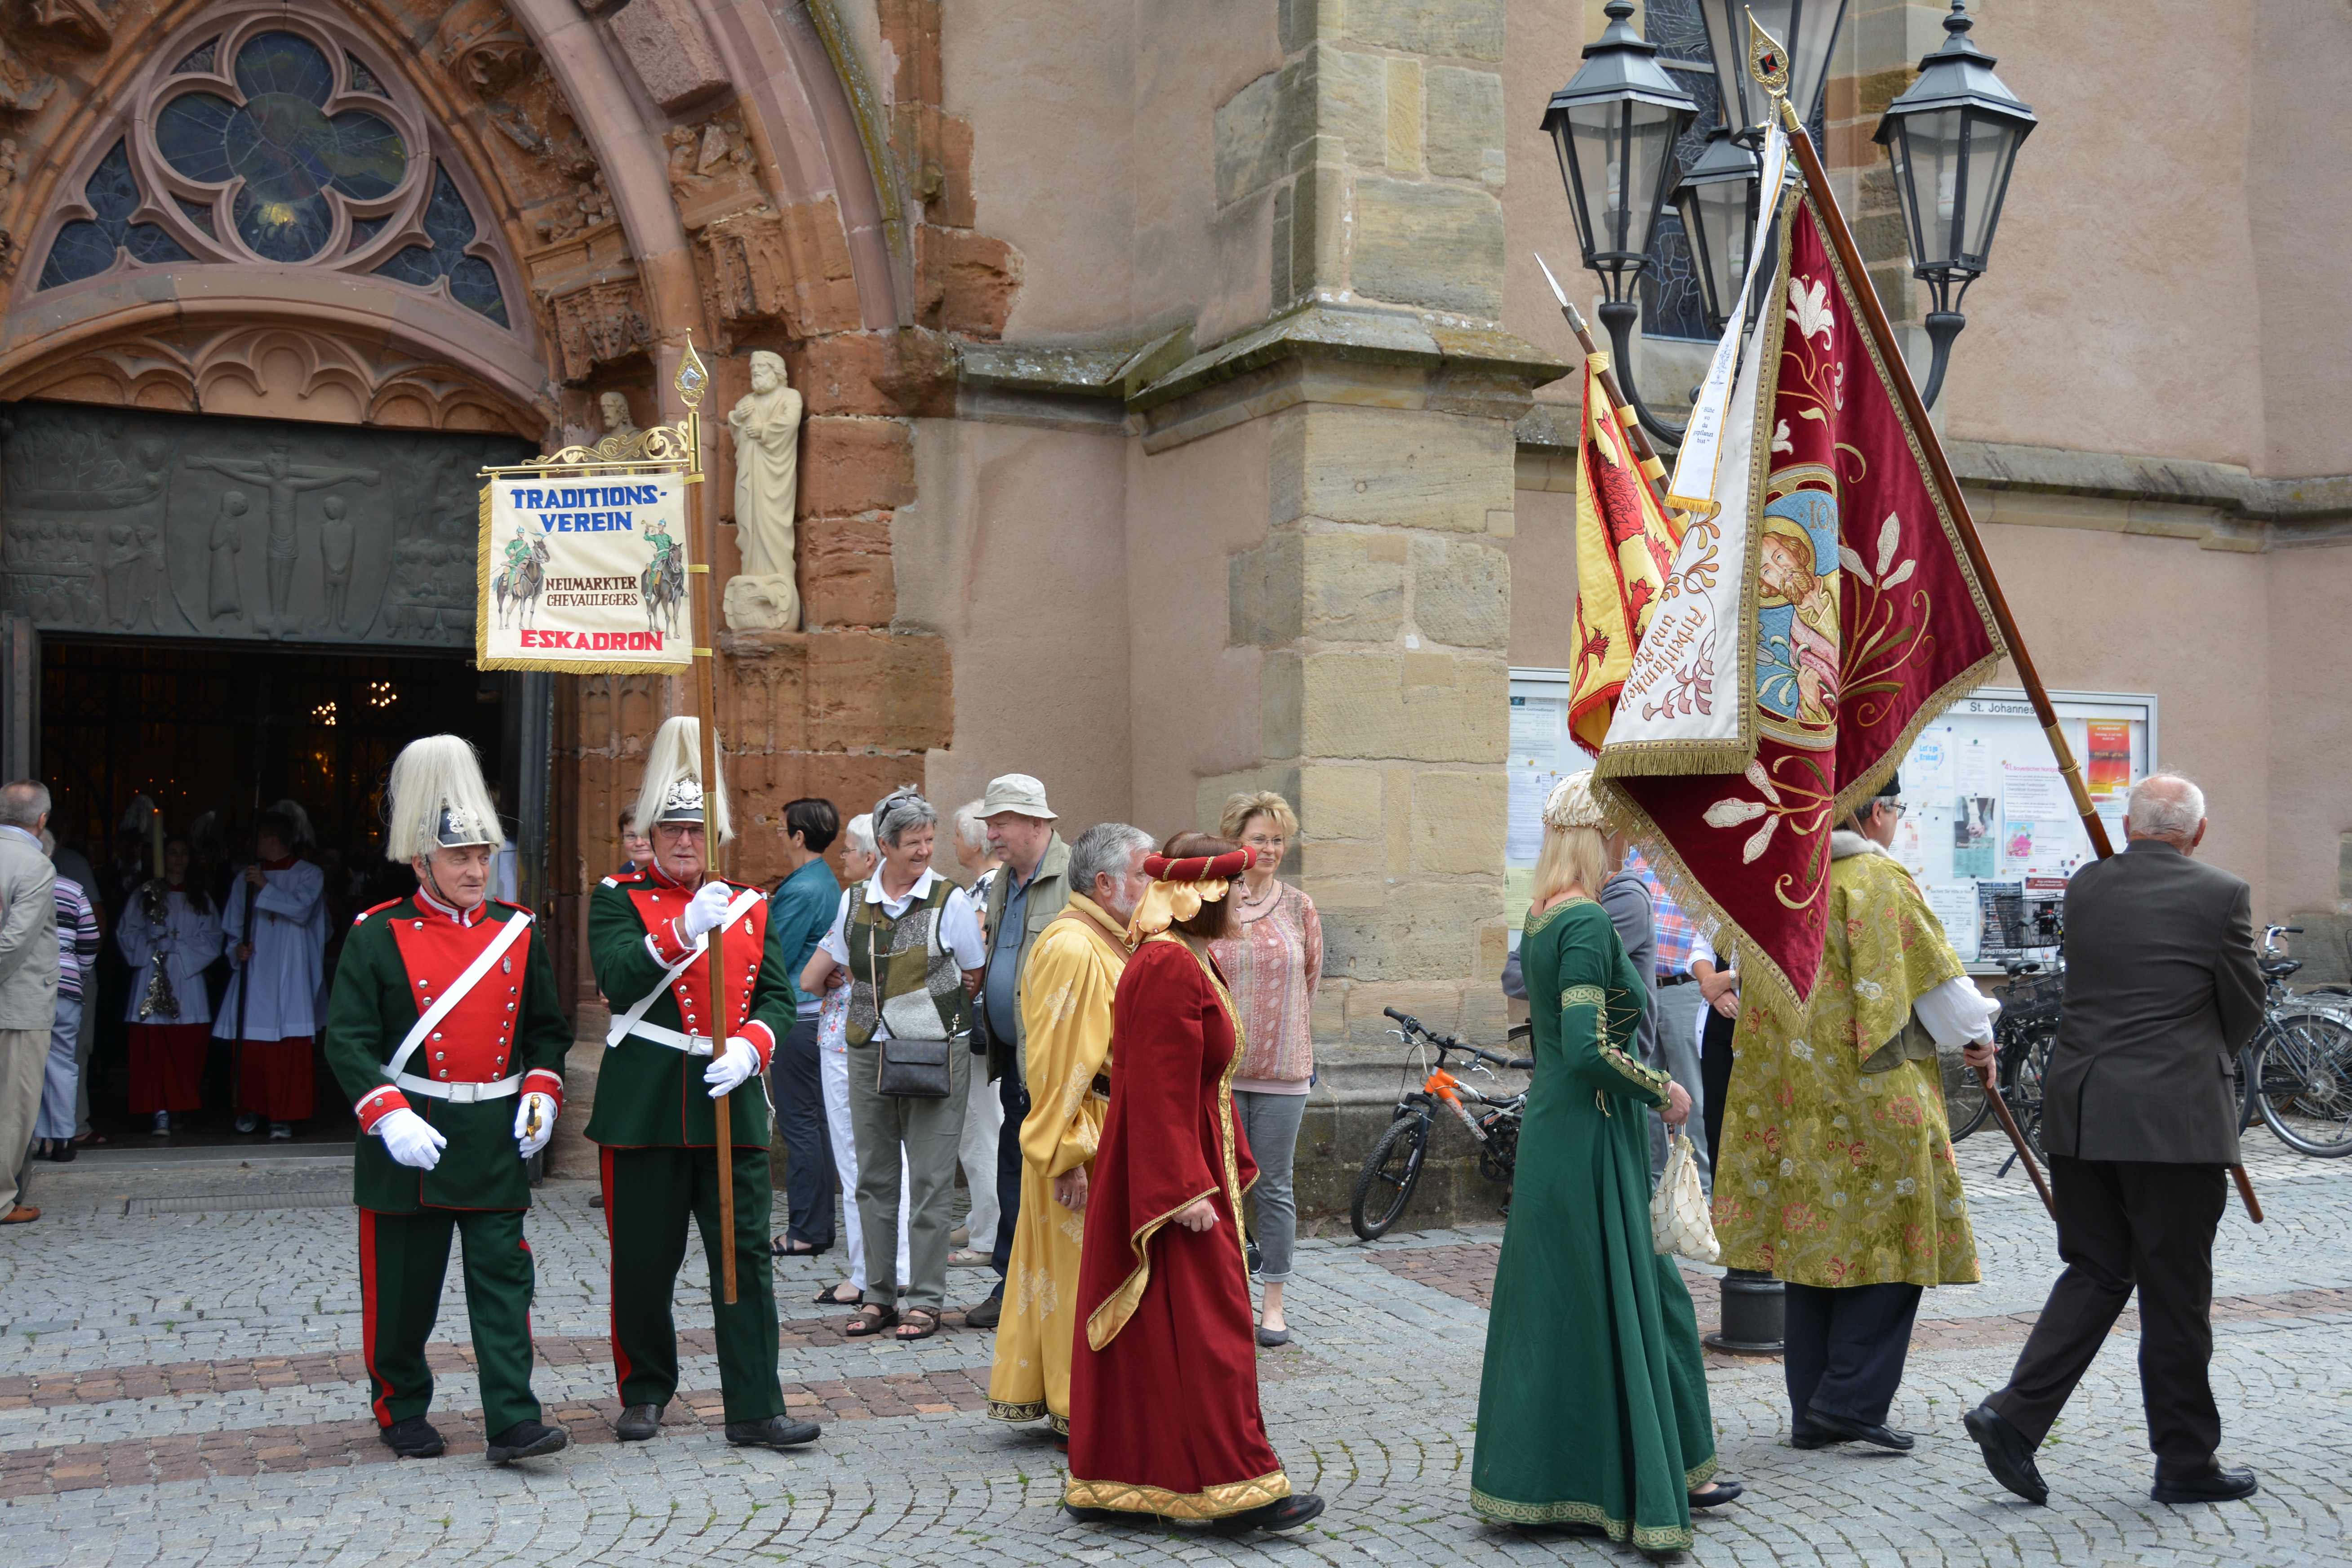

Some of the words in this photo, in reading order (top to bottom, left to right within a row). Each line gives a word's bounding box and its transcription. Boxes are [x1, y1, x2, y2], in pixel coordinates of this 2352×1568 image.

[510, 485, 667, 509] TRADITIONS-
[538, 511, 632, 532] VEREIN
[545, 576, 638, 591] NEUMARKTER
[547, 593, 638, 607] CHEVAULEGERS
[520, 629, 664, 651] ESKADRON
[1651, 614, 1676, 647] und
[1970, 702, 1984, 712] St.
[1988, 702, 2035, 714] Johannes
